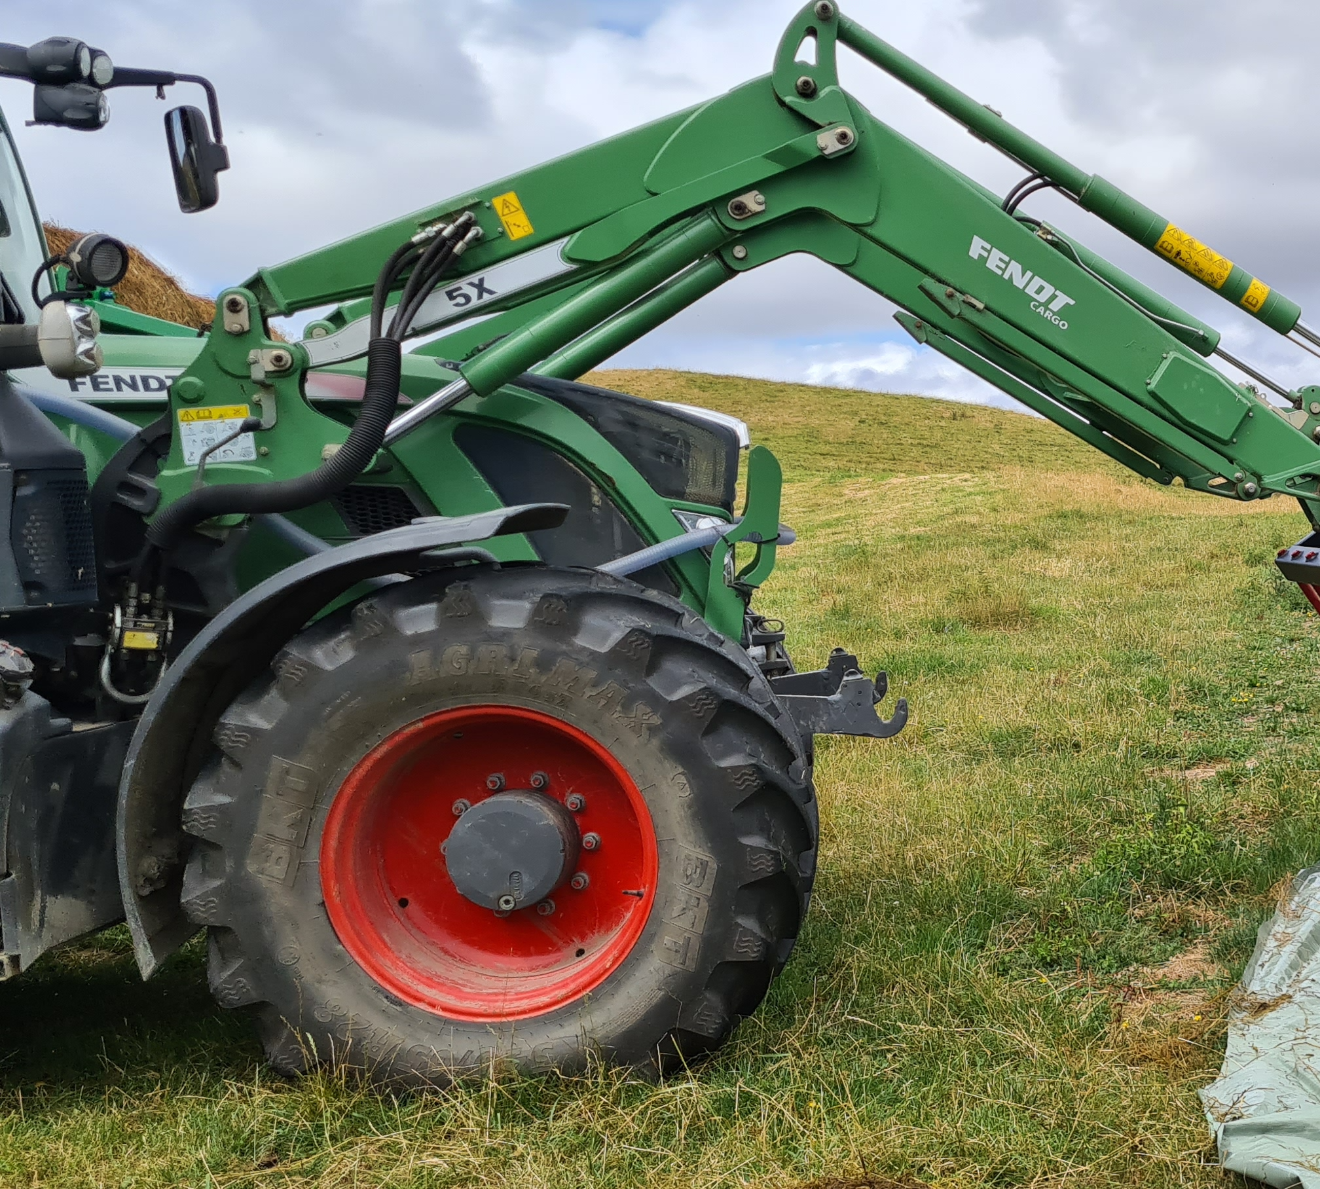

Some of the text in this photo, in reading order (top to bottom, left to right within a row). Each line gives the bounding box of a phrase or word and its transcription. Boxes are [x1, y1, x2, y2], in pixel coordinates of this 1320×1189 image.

[968, 234, 1076, 313] FENDT
[444, 276, 498, 308] 5X
[1030, 301, 1069, 330] CARGO
